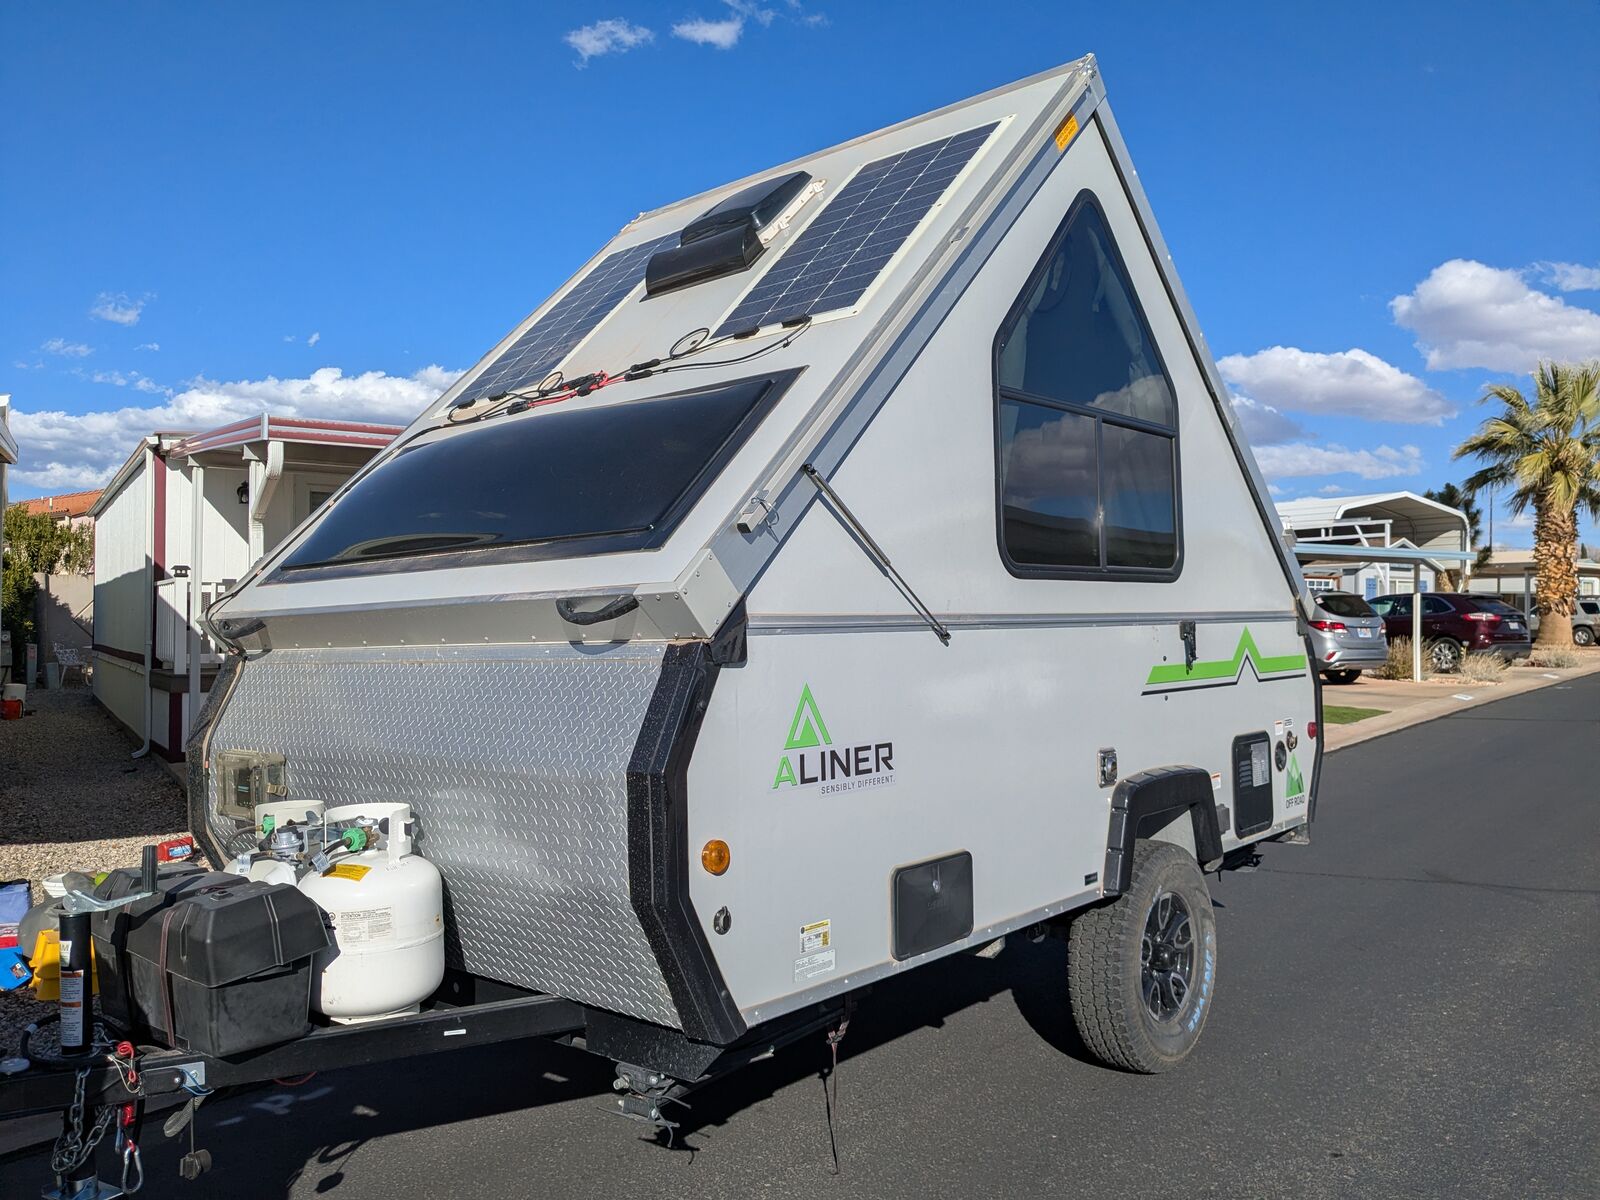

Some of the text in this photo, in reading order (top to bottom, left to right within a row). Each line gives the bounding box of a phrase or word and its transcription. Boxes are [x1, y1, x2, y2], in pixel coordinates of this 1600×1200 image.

[772, 742, 895, 790] ALINER
[821, 774, 896, 795] SENSIBLY DIFFERENT.
[1286, 794, 1305, 809] OFF ROAD
